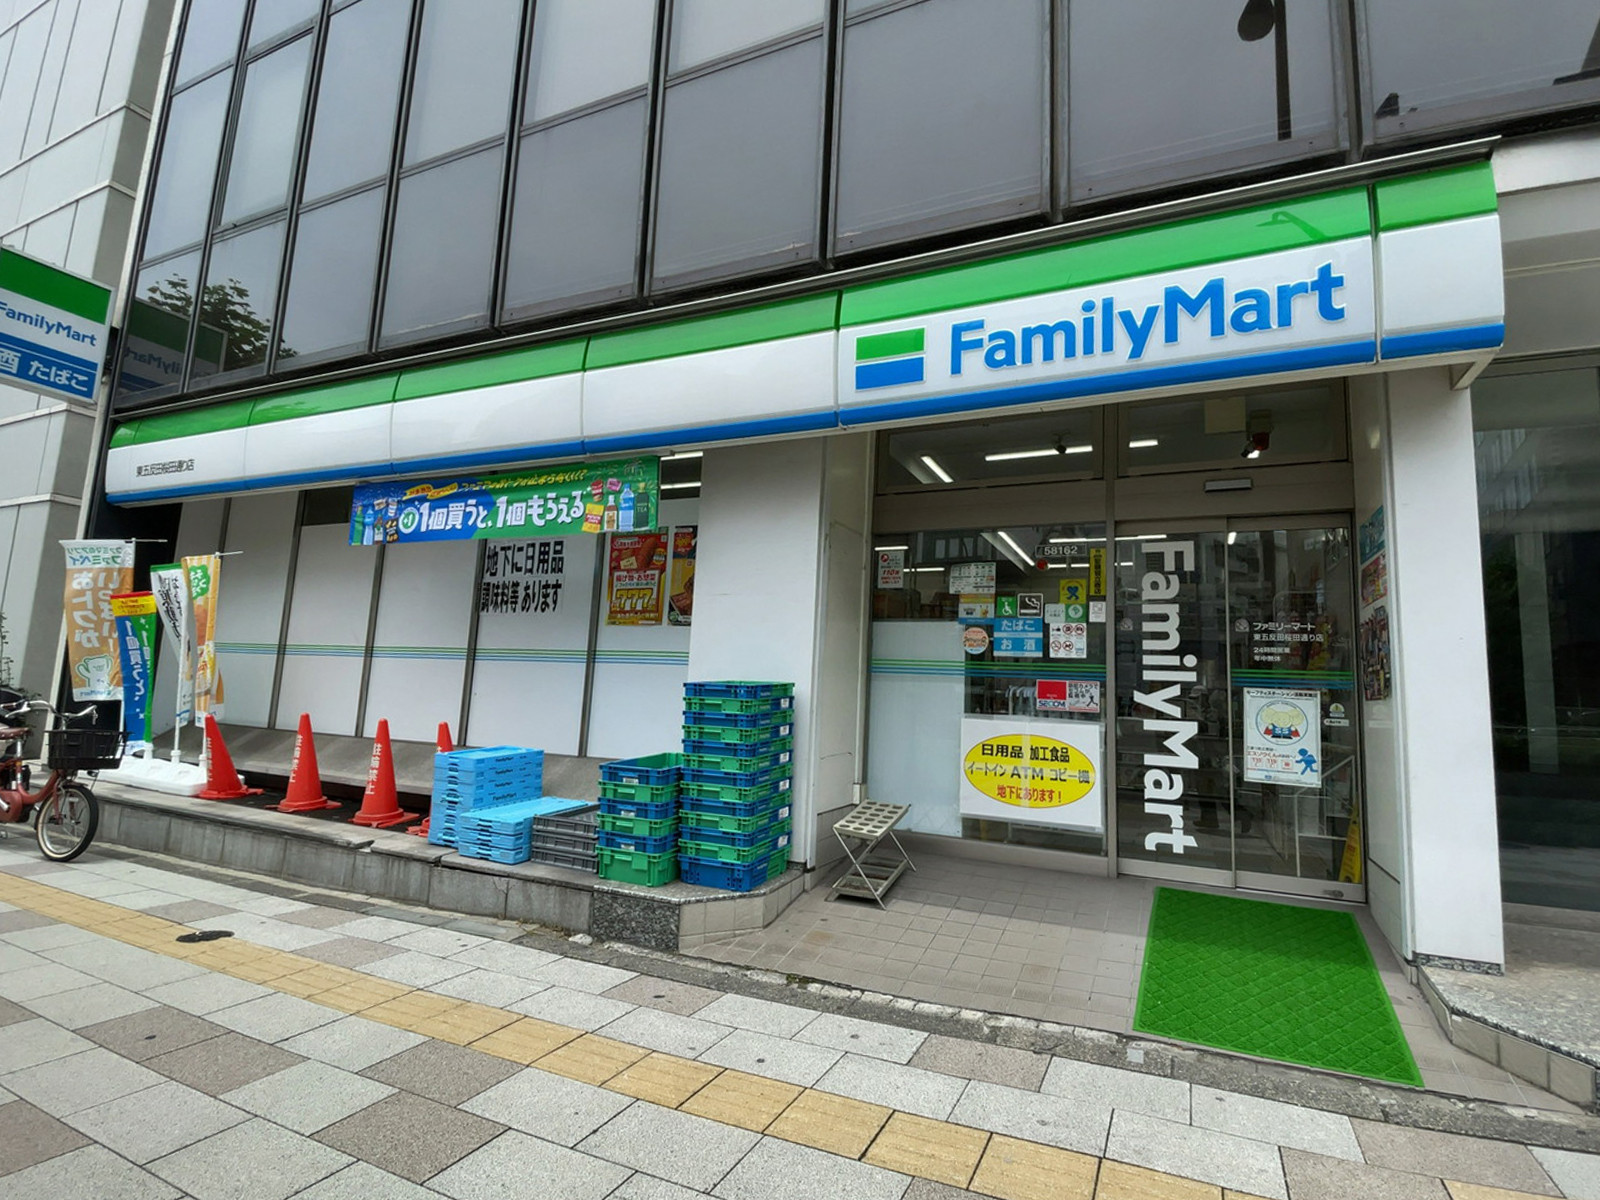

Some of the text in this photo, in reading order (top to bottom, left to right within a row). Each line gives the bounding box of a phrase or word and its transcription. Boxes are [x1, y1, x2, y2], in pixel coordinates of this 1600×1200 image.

[950, 261, 1346, 375] FamilyMart
[28, 360, 89, 391] たばこ
[486, 541, 564, 577] 地下に日用品
[1044, 545, 1078, 555] 58162
[616, 588, 653, 610] 777
[1001, 620, 1035, 631] たばこ
[1253, 622, 1316, 631] ファミリーマート
[1038, 700, 1066, 708] SECOM
[1133, 540, 1199, 855] FamilyMart
[981, 743, 1070, 763] 日用品 加工食品
[967, 761, 1090, 784] イートイン ATM コピー機
